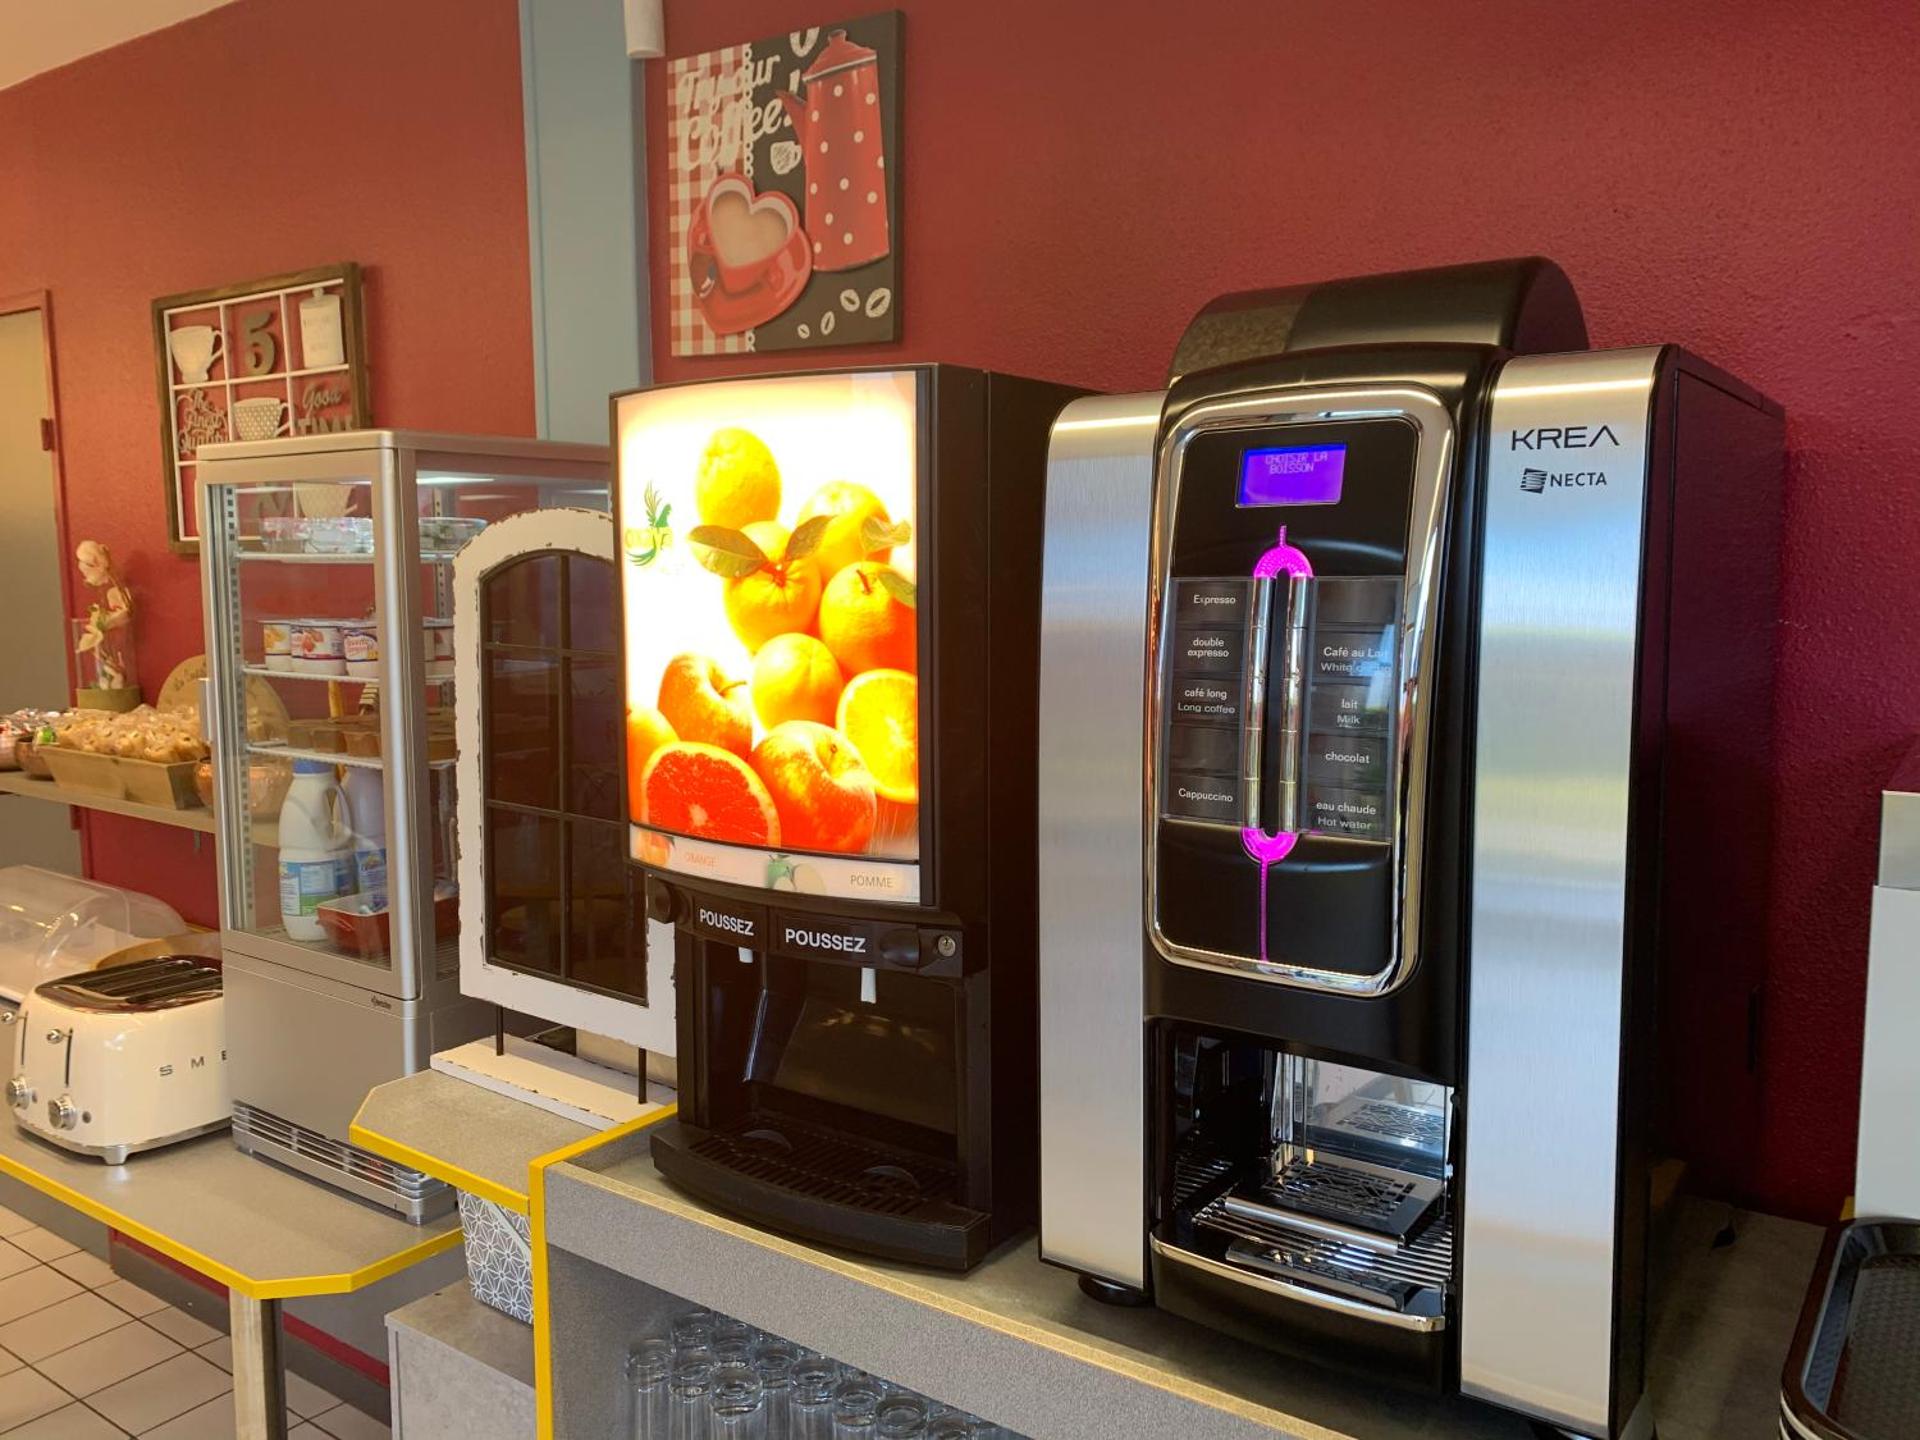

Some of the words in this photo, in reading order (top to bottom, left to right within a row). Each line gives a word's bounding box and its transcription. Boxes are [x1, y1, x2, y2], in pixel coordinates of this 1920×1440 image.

[244, 309, 275, 376] 5
[303, 381, 344, 420] Good
[1511, 424, 1620, 451] KREA
[1313, 451, 1328, 462] LA
[1269, 462, 1314, 475] BOISSON
[1550, 472, 1607, 487] NECTA
[1193, 594, 1236, 606] Expresso
[1193, 637, 1224, 647] double
[1187, 648, 1229, 659] expresso
[1351, 647, 1365, 657] au
[1321, 661, 1353, 672] White
[1184, 687, 1205, 697] café
[1206, 688, 1227, 700] long
[1178, 701, 1201, 713] Long
[1204, 703, 1235, 714] coffee
[1341, 699, 1358, 709] lait
[1336, 714, 1360, 724] Milk
[1325, 751, 1370, 764] chocolat
[1178, 787, 1234, 802] Cappuccino
[1316, 802, 1335, 811] eau
[1337, 801, 1377, 815] chaude
[1318, 817, 1336, 827] Hot
[1340, 819, 1371, 830] water
[850, 874, 894, 888] POMME
[700, 908, 754, 936] POUSSEZ
[785, 928, 866, 953] POUSSEZ
